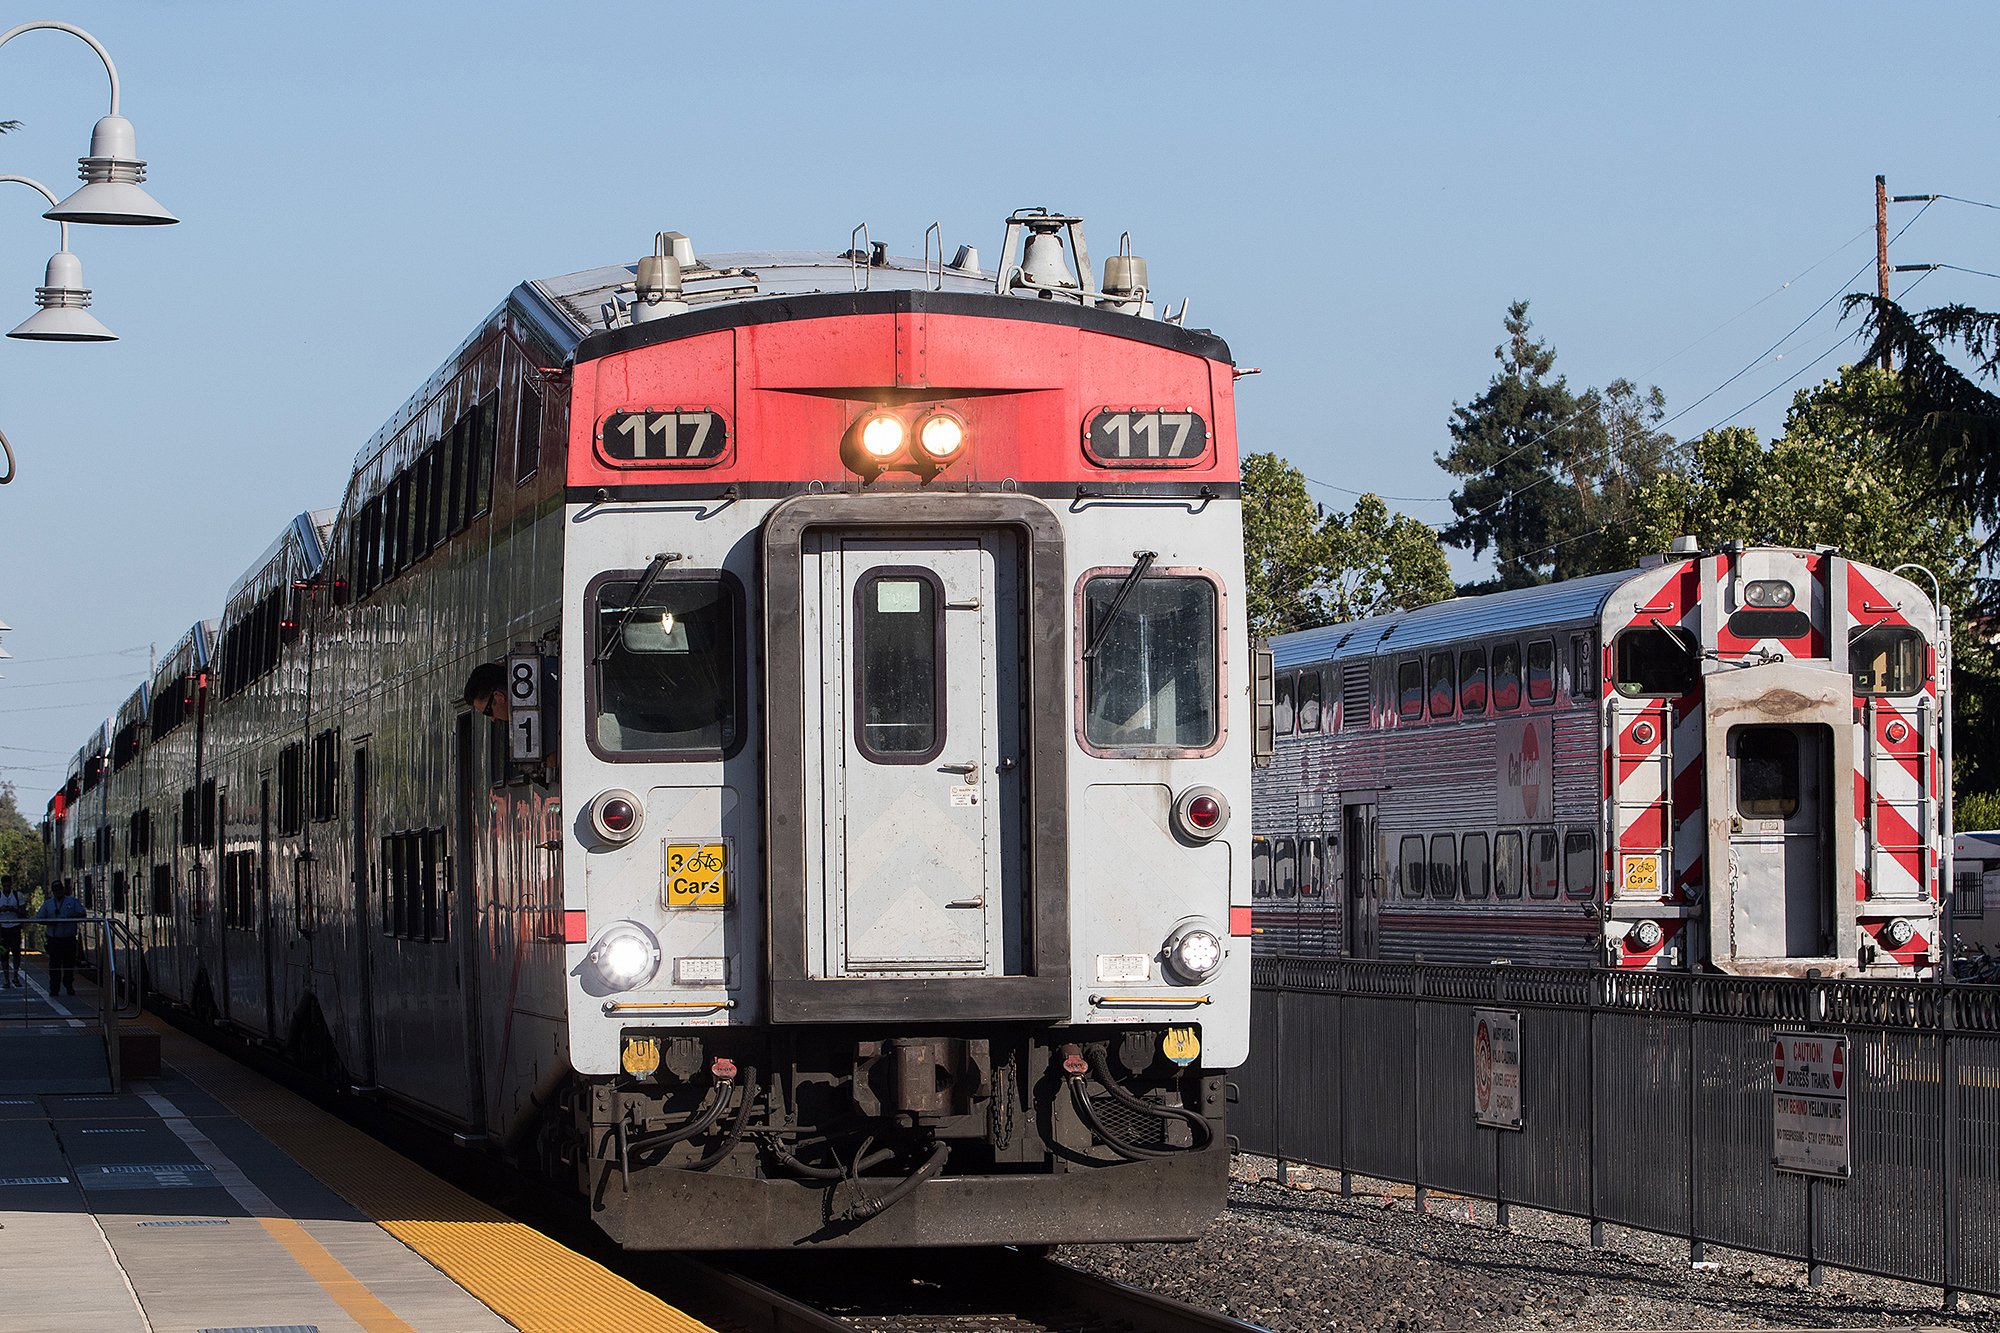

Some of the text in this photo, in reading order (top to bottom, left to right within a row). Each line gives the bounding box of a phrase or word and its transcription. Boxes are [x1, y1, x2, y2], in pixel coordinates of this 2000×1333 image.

[617, 414, 712, 457] 117
[1102, 414, 1192, 457] 117
[671, 854, 683, 873] 3
[1628, 863, 1635, 873] 2
[674, 878, 720, 894] Cars
[1630, 875, 1653, 884] Cars
[1793, 1041, 1823, 1063] CAUTION!
[1787, 1071, 1830, 1090] EXPRESS TRAINS
[1777, 1097, 1842, 1119] STAY BEHIND YELLOW LINE
[1808, 1131, 1818, 1144] STAY
[1818, 1132, 1826, 1145] OFF
